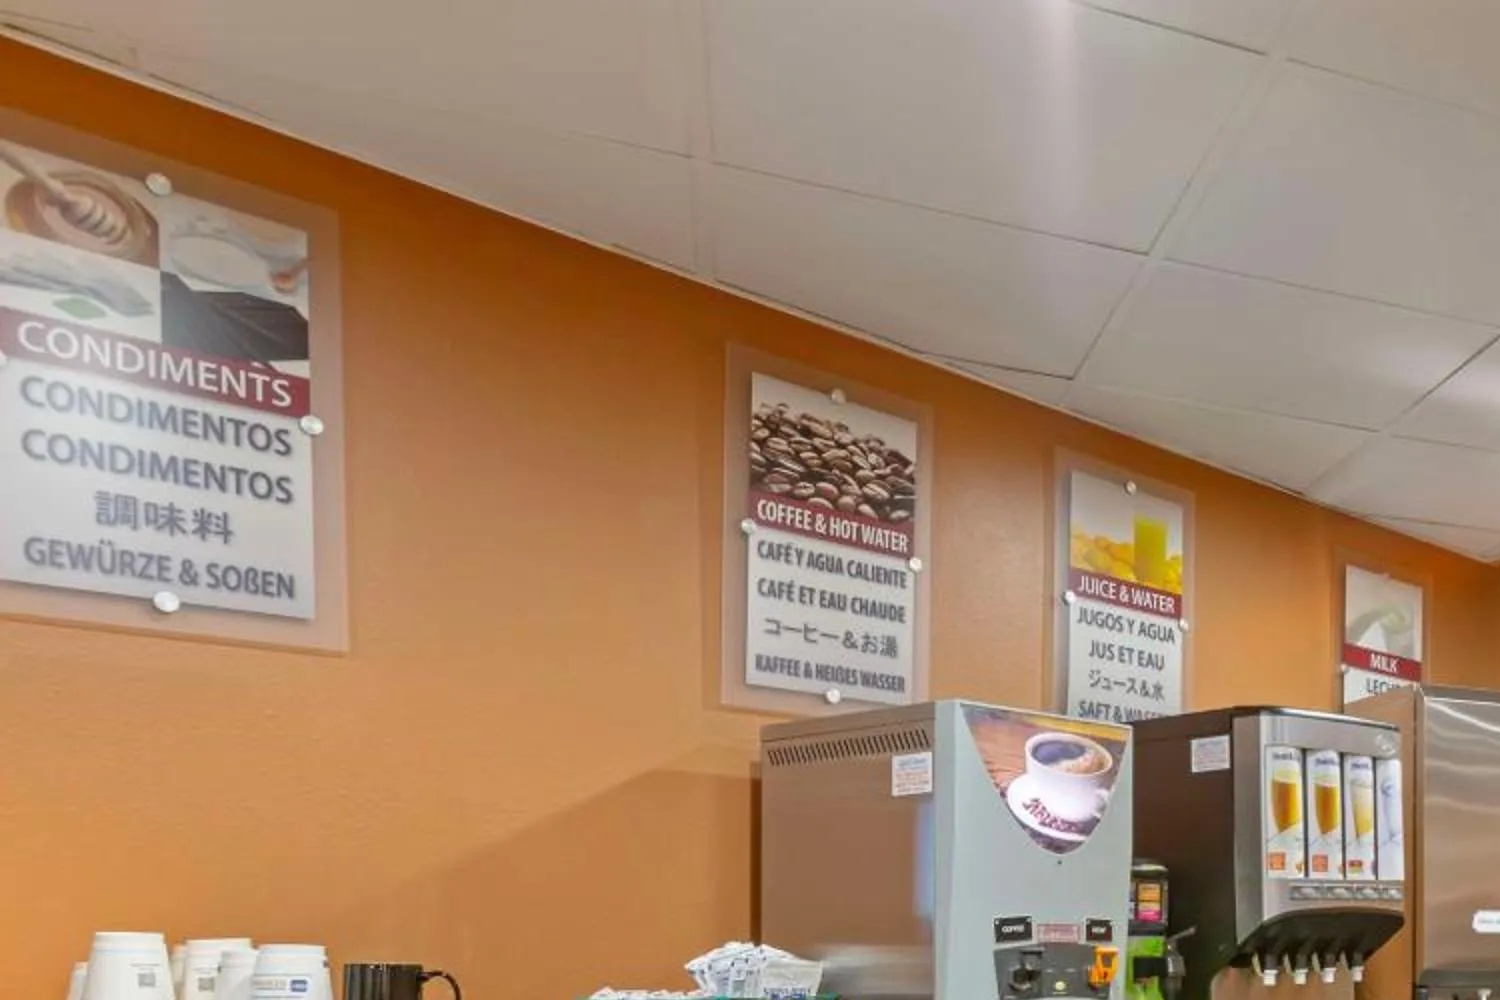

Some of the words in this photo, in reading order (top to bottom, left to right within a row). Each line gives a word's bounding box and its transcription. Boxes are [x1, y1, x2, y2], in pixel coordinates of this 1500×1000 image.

[17, 320, 292, 408] CONDIMENTS
[19, 375, 292, 457] CONDIMENTOS
[21, 429, 293, 505] CONDIMENTOS
[95, 490, 233, 545] 調味料
[757, 499, 812, 533] COFFEE
[815, 513, 828, 535] &
[829, 519, 858, 543] HOT
[861, 524, 909, 553] WATER
[23, 537, 172, 584] GEWÜRZE
[178, 560, 199, 587] &
[757, 538, 794, 566] CAFÉ
[794, 547, 804, 567] Y
[806, 549, 844, 574] AGUA
[847, 560, 907, 589] CALIENTE
[757, 577, 795, 602] CAFÉ
[799, 584, 816, 605] ET
[820, 588, 847, 611] EAU
[851, 593, 906, 624] CHAUDE
[1078, 575, 1117, 601] JUICE
[1120, 584, 1129, 603] &
[1131, 588, 1175, 614] WATER
[1076, 606, 1123, 635] JUGOS
[1125, 617, 1135, 635] Y
[1138, 621, 1176, 644] AGUA
[755, 653, 801, 678] KAFFEE
[860, 669, 906, 693] WASSER
[1088, 639, 1115, 662] JUS
[1118, 646, 1133, 665] ET
[1138, 649, 1165, 671] EAU
[1370, 652, 1399, 674] MILK
[1078, 700, 1111, 720] SAFT
[1113, 705, 1123, 723] &
